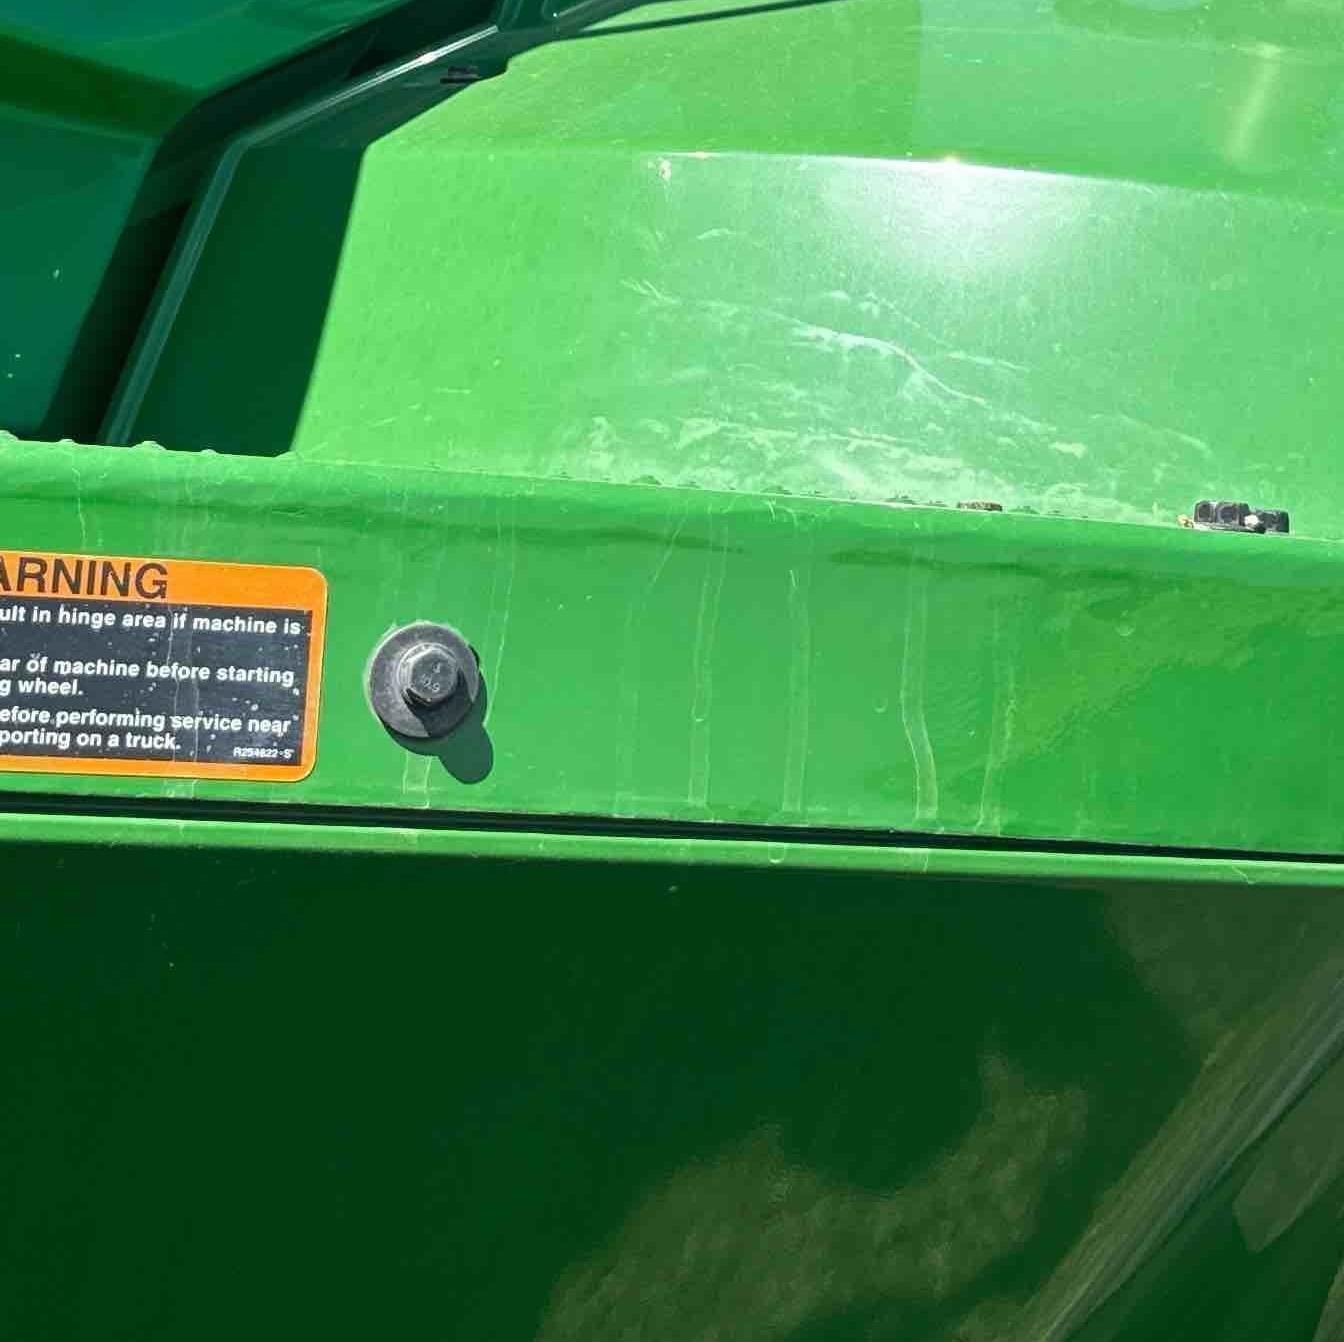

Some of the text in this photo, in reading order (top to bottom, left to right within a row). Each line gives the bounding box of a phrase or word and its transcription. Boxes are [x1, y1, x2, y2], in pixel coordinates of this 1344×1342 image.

[32, 607, 52, 622] in
[58, 608, 116, 628] hinge
[122, 613, 166, 627] area
[173, 613, 186, 628] if
[193, 614, 277, 634] machine
[284, 618, 301, 634] is
[26, 658, 46, 673] of
[54, 659, 139, 677] machine
[146, 662, 210, 679] before
[216, 666, 295, 688] starting
[18, 678, 83, 696] wheel.
[56, 708, 165, 730] performing
[172, 713, 242, 730] service
[248, 718, 290, 732] near
[76, 732, 102, 746] on
[107, 734, 119, 747] a
[126, 731, 180, 749] truck.
